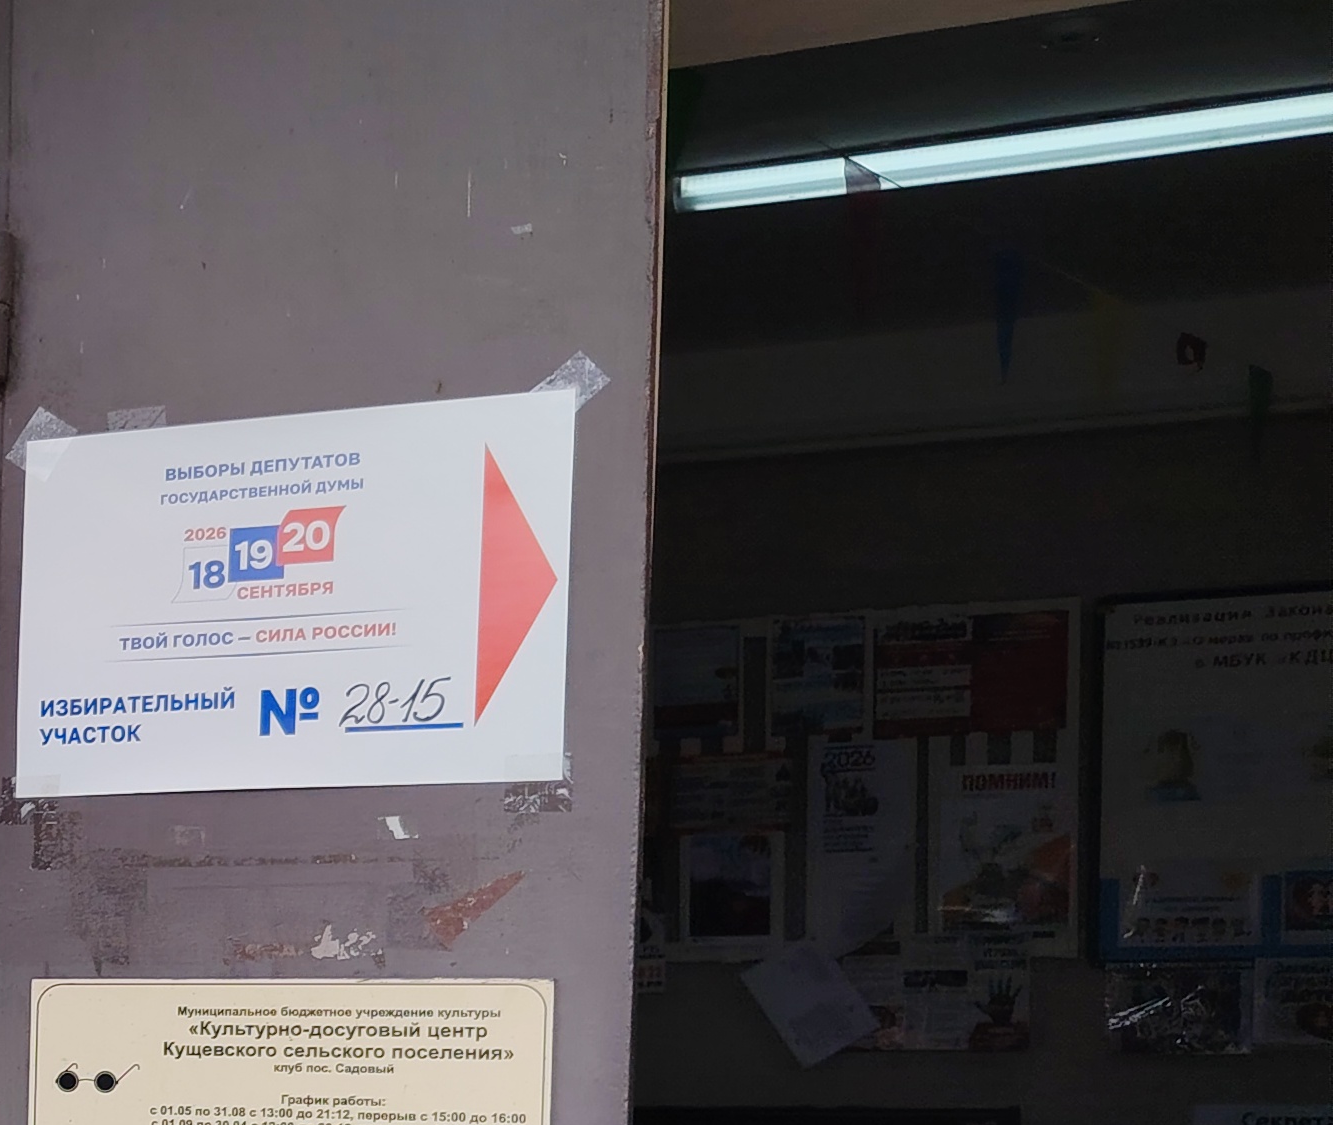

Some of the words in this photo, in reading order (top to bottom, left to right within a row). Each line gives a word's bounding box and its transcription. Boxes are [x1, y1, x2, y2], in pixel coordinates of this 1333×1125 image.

[165, 462, 245, 482] ВЫБОРЫ
[249, 452, 361, 477] ДЕПУТАТОВ
[160, 479, 312, 505] ГОСУДАРСТВЕННОЙ
[315, 478, 364, 495] ДУМЫ
[183, 526, 227, 542] 2026
[188, 560, 226, 590] 18
[234, 539, 273, 571] 19
[282, 520, 331, 553] 20
[236, 581, 334, 600] СЕНТЯБРЯ
[119, 630, 169, 651] ТВОЙ
[172, 632, 234, 648] ГОЛОС
[255, 627, 307, 643] СИЛА
[312, 622, 397, 640] РОССИИ!
[39, 686, 236, 718] ИЗБИРАТЕЛЬНЫЙ
[259, 686, 320, 736] №
[338, 676, 452, 728] 28-15
[39, 723, 142, 746] УЧАСТОК
[962, 772, 1057, 792] ПОМНИМ!
[177, 1006, 277, 1018] Муниципальное
[281, 1006, 352, 1018] бюджетное
[355, 1008, 434, 1020] учреждение
[437, 1009, 501, 1020] культуры
[188, 1021, 421, 1039] «Культурно-досуговый
[427, 1025, 489, 1041] центр
[163, 1041, 277, 1059] Кущевского
[282, 1045, 385, 1059] сельского
[391, 1047, 514, 1061] поселения»
[273, 1061, 303, 1074] клуб
[306, 1064, 332, 1073] пос.
[335, 1062, 394, 1075] Садовый
[281, 1094, 329, 1106] График
[332, 1095, 386, 1107] работы:
[160, 1105, 192, 1116] 01.05
[195, 1108, 211, 1117] по
[213, 1107, 246, 1117] 31.08
[249, 1109, 257, 1118] с
[260, 1107, 293, 1118] 13:00
[296, 1110, 313, 1120] до
[316, 1109, 354, 1121] 21:12,
[357, 1112, 416, 1123] перерыв
[420, 1113, 428, 1122] с
[432, 1112, 466, 1122] 15:00
[469, 1114, 487, 1124] до
[491, 1113, 527, 1124] 16:00
